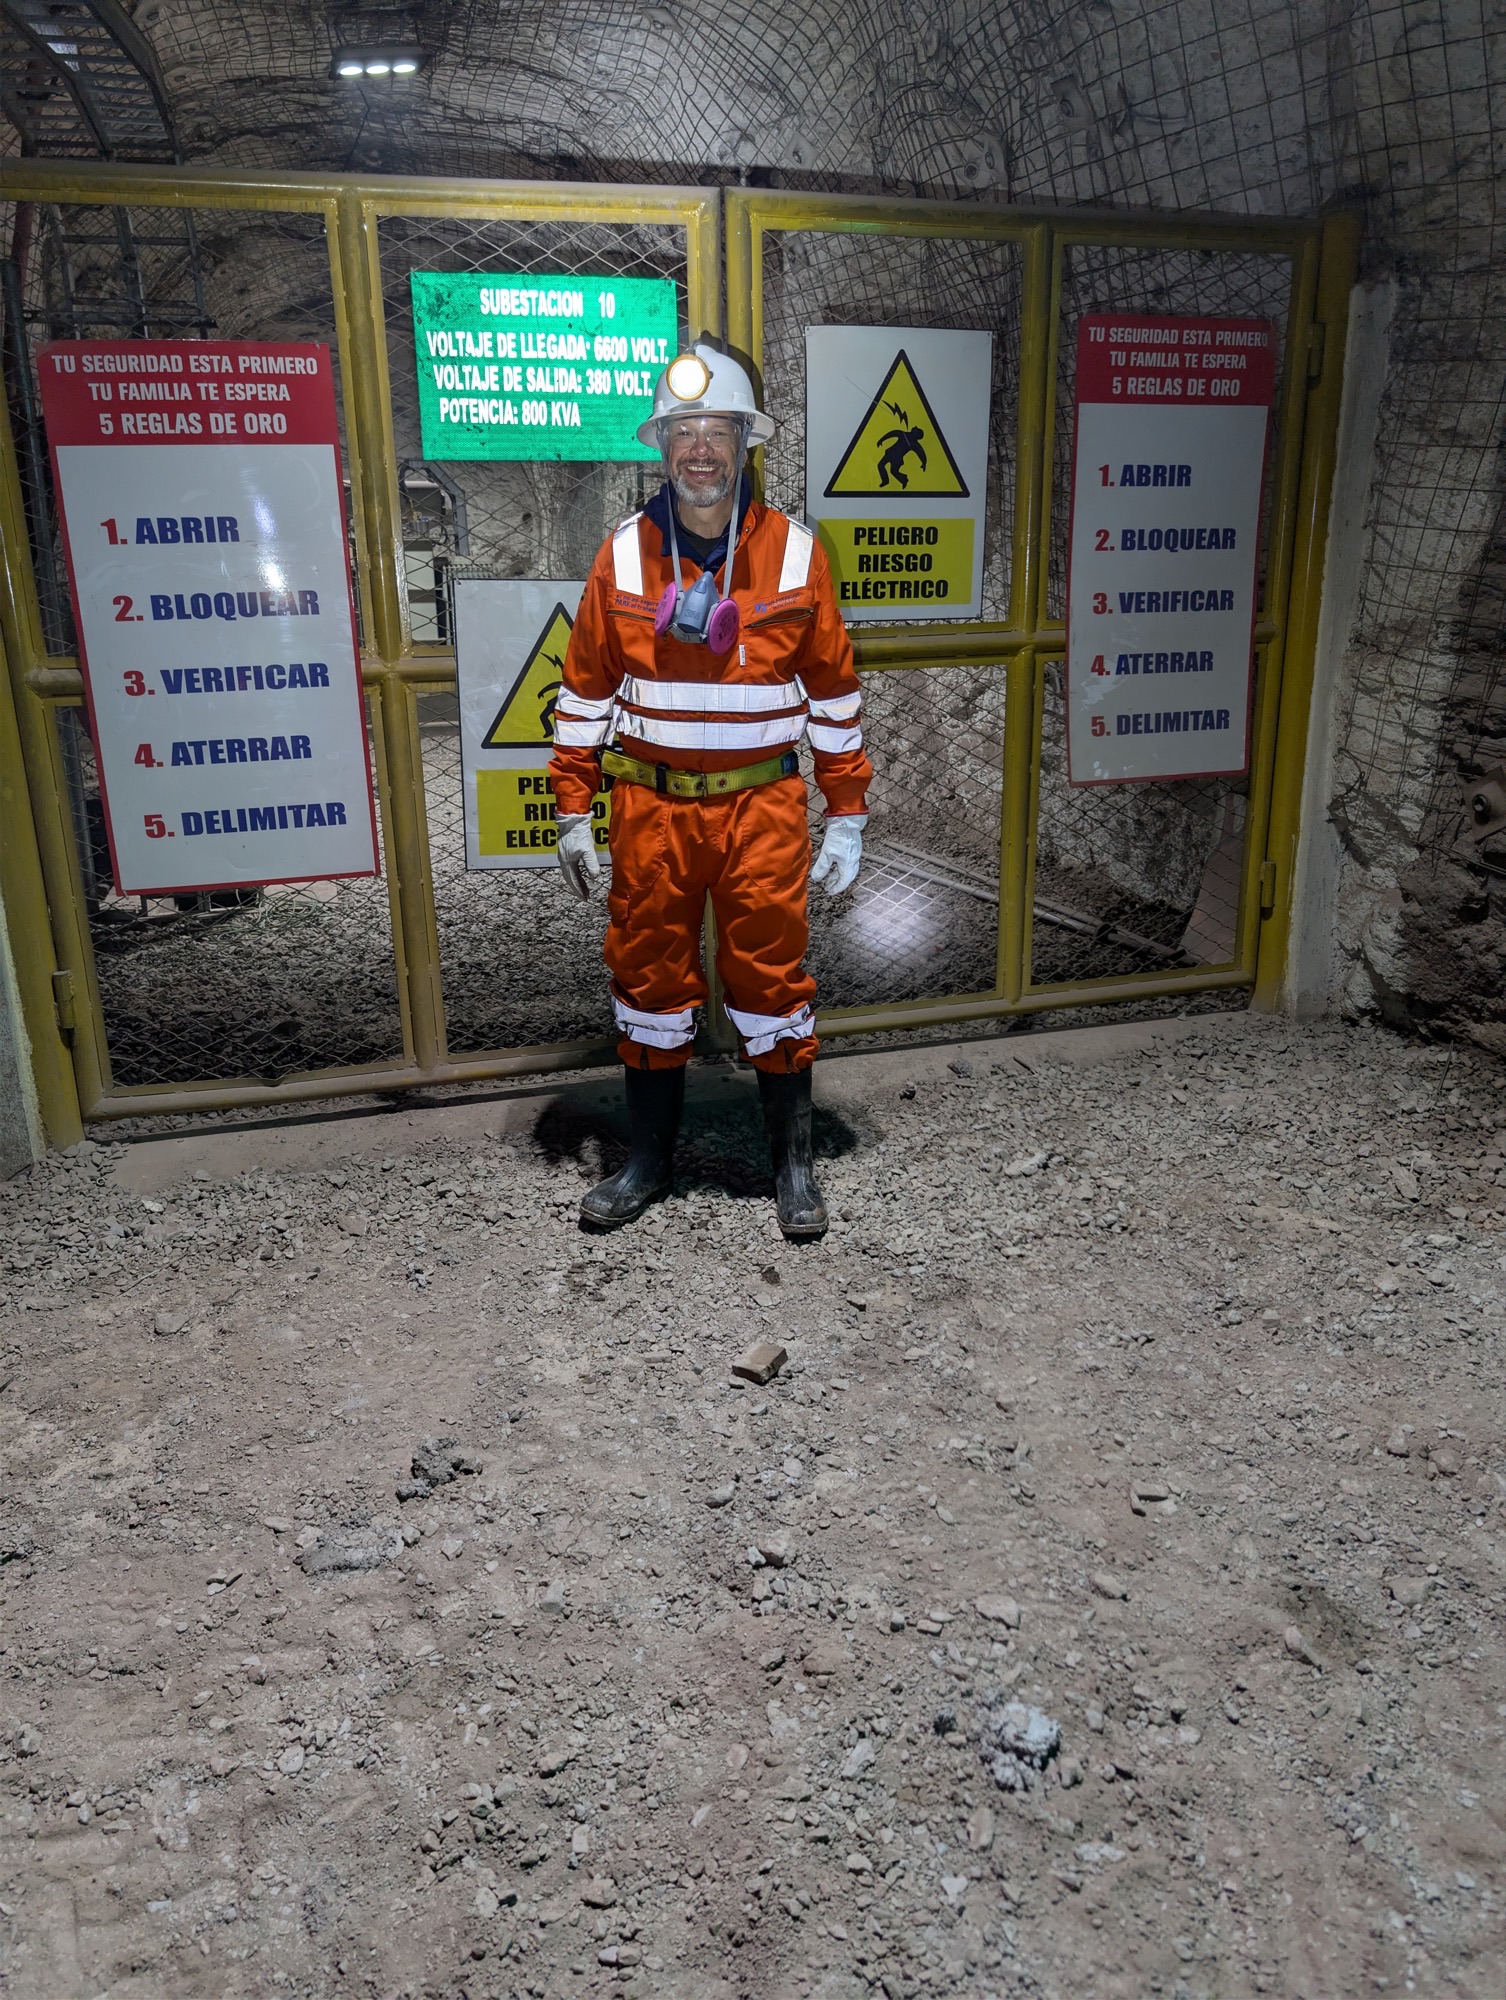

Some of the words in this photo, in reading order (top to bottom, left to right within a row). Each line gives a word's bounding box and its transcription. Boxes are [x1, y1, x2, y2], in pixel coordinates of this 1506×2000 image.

[480, 288, 583, 318] SUBESTACION
[598, 291, 616, 319] 10
[426, 331, 494, 358] VOLTAJE
[497, 332, 517, 358] DE
[594, 336, 628, 362] 6600
[631, 337, 669, 364] VOLT.
[1088, 327, 1106, 342] TU
[1109, 327, 1178, 345] SEGURIDAD
[1182, 330, 1212, 346] ESTA
[1215, 331, 1268, 347] PRIMERO
[52, 355, 76, 374] TU
[82, 355, 183, 374] SEGURIDAD
[189, 355, 233, 374] ESTA
[238, 356, 318, 375] PRIMERO
[1110, 351, 1126, 366] TU
[1129, 351, 1180, 368] FAMILIA
[1184, 353, 1199, 368] TE
[1202, 353, 1247, 369] ESPERA
[88, 383, 112, 401] TU
[119, 383, 192, 401] FAMILIA
[197, 383, 219, 401] TE
[225, 383, 291, 402] ESPERA
[433, 364, 500, 391] VOLTAJE
[503, 366, 523, 392] DE
[526, 366, 582, 393] SALIDA:
[585, 369, 611, 395] 380
[614, 370, 653, 397] VOLT.
[1112, 376, 1122, 394] 5
[1127, 377, 1182, 395] REGLAS
[1187, 378, 1205, 396] DE
[1210, 379, 1240, 397] ORO
[99, 413, 113, 435] 5
[121, 412, 203, 434] REGLAS
[210, 412, 237, 434] DE
[244, 412, 287, 434] ORO
[439, 397, 519, 425] POTENCIA:
[521, 400, 548, 426] 800
[551, 401, 581, 427] KVA
[1098, 464, 1115, 487] 1.
[1120, 464, 1192, 487] ABRIR
[100, 518, 128, 545] 1.
[135, 516, 240, 544] ABRIR
[854, 526, 939, 546] PELIGRO
[1095, 529, 1115, 551] 2.
[1121, 528, 1237, 553] BLOQUEAR
[858, 553, 933, 573] RIESGO
[840, 577, 949, 600] ELÉCTRICO
[112, 595, 144, 622] 2.
[150, 590, 320, 621] BLOQUEAR
[1092, 592, 1113, 615] 3.
[1118, 590, 1235, 614] VERIFICAR
[1090, 654, 1111, 676] 4.
[1115, 650, 1214, 675] ATERRAR
[123, 670, 155, 696] 3.
[160, 662, 330, 694] VERIFICAR
[1091, 715, 1111, 737] 5.
[1116, 709, 1230, 736] DELIMITAR
[134, 743, 164, 768] 4.
[170, 734, 312, 766] ATERRAR
[518, 774, 613, 795] PELO
[144, 814, 175, 839] 5.
[181, 802, 347, 836] DELIMITAR
[524, 800, 606, 821] RIEO
[506, 826, 608, 848] ELÉCC
